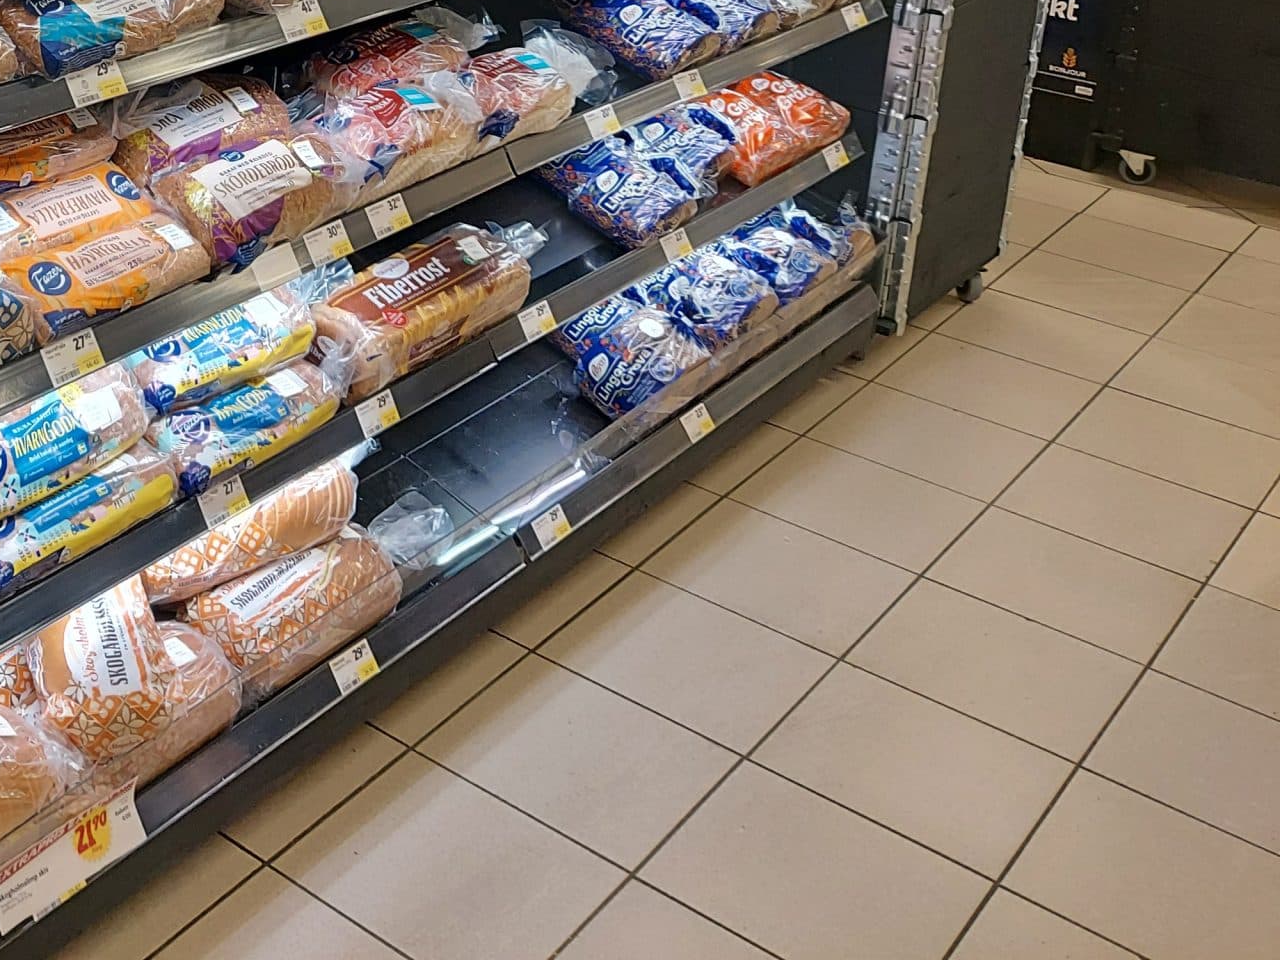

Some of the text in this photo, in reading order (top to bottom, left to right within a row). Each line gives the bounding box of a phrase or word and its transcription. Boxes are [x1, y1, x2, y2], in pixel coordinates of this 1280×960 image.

[213, 152, 296, 198] SKÖRDEBRÖD
[31, 264, 63, 293] Fazer
[361, 256, 452, 310] Fiberrost
[568, 304, 602, 338] Lingon
[597, 359, 629, 402] Lingon
[620, 347, 652, 386] Grova
